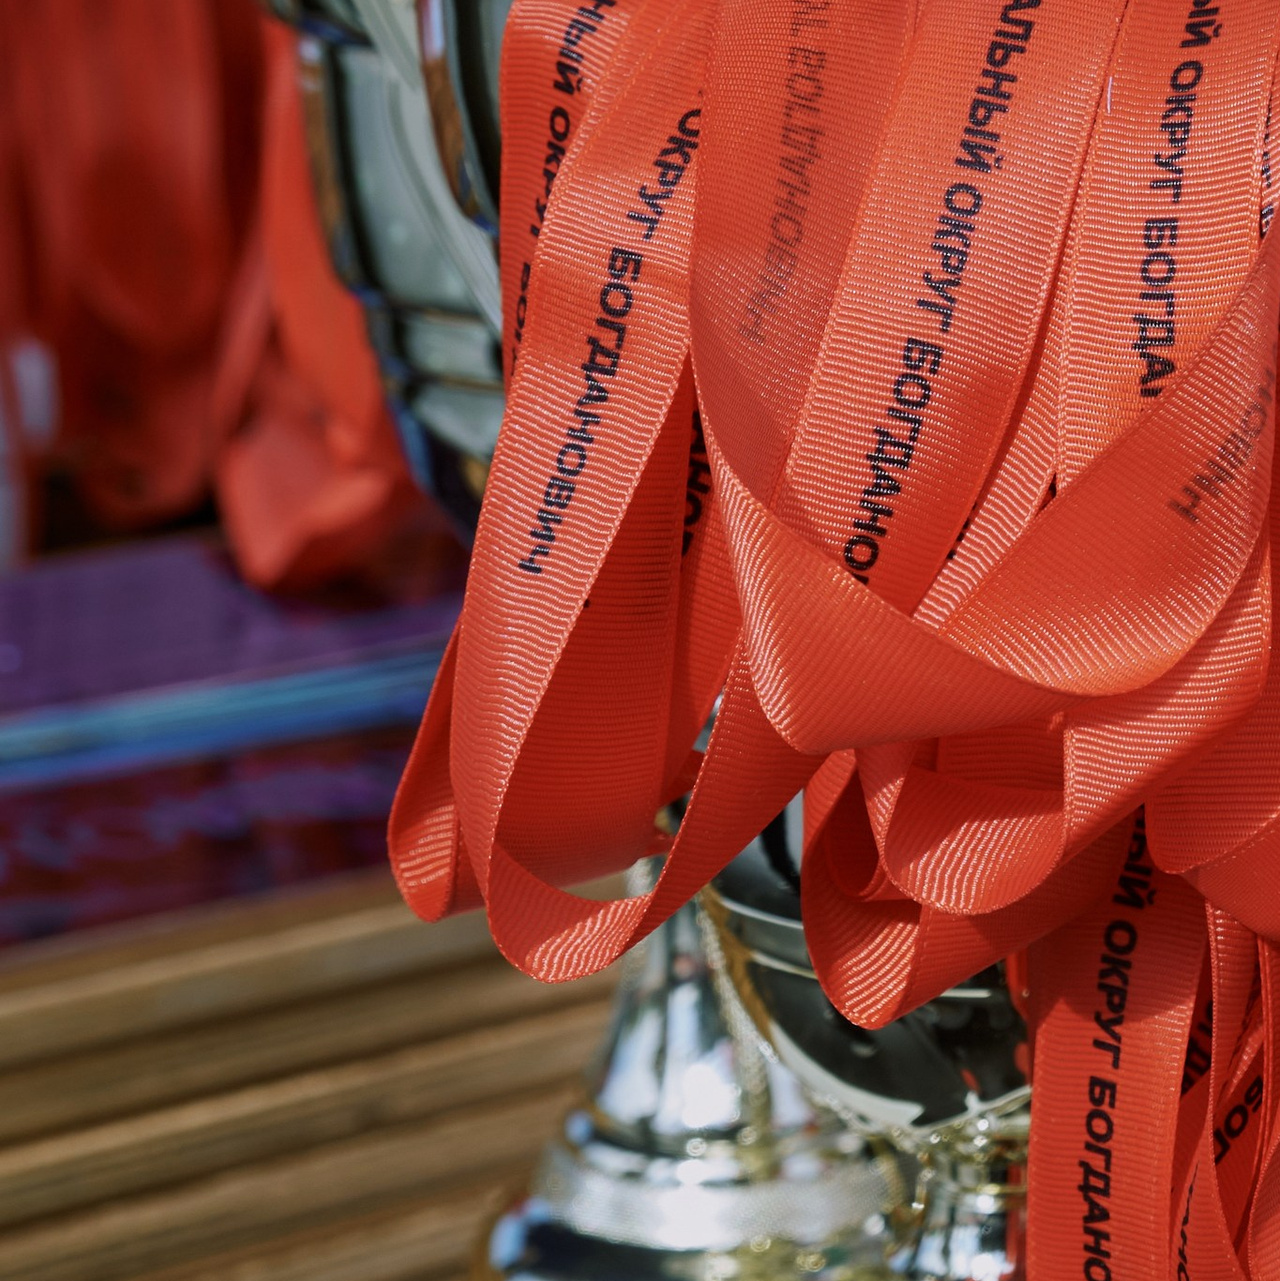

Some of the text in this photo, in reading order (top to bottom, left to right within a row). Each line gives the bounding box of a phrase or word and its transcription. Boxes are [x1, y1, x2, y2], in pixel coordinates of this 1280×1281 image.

[1151, 59, 1204, 205] ОКРУГ
[917, 182, 984, 334] ОКРУГ
[518, 249, 643, 576] БОГДАНОВИЧ
[842, 336, 943, 586] БОГДАНО
[1094, 918, 1140, 1068] ОКРУГ
